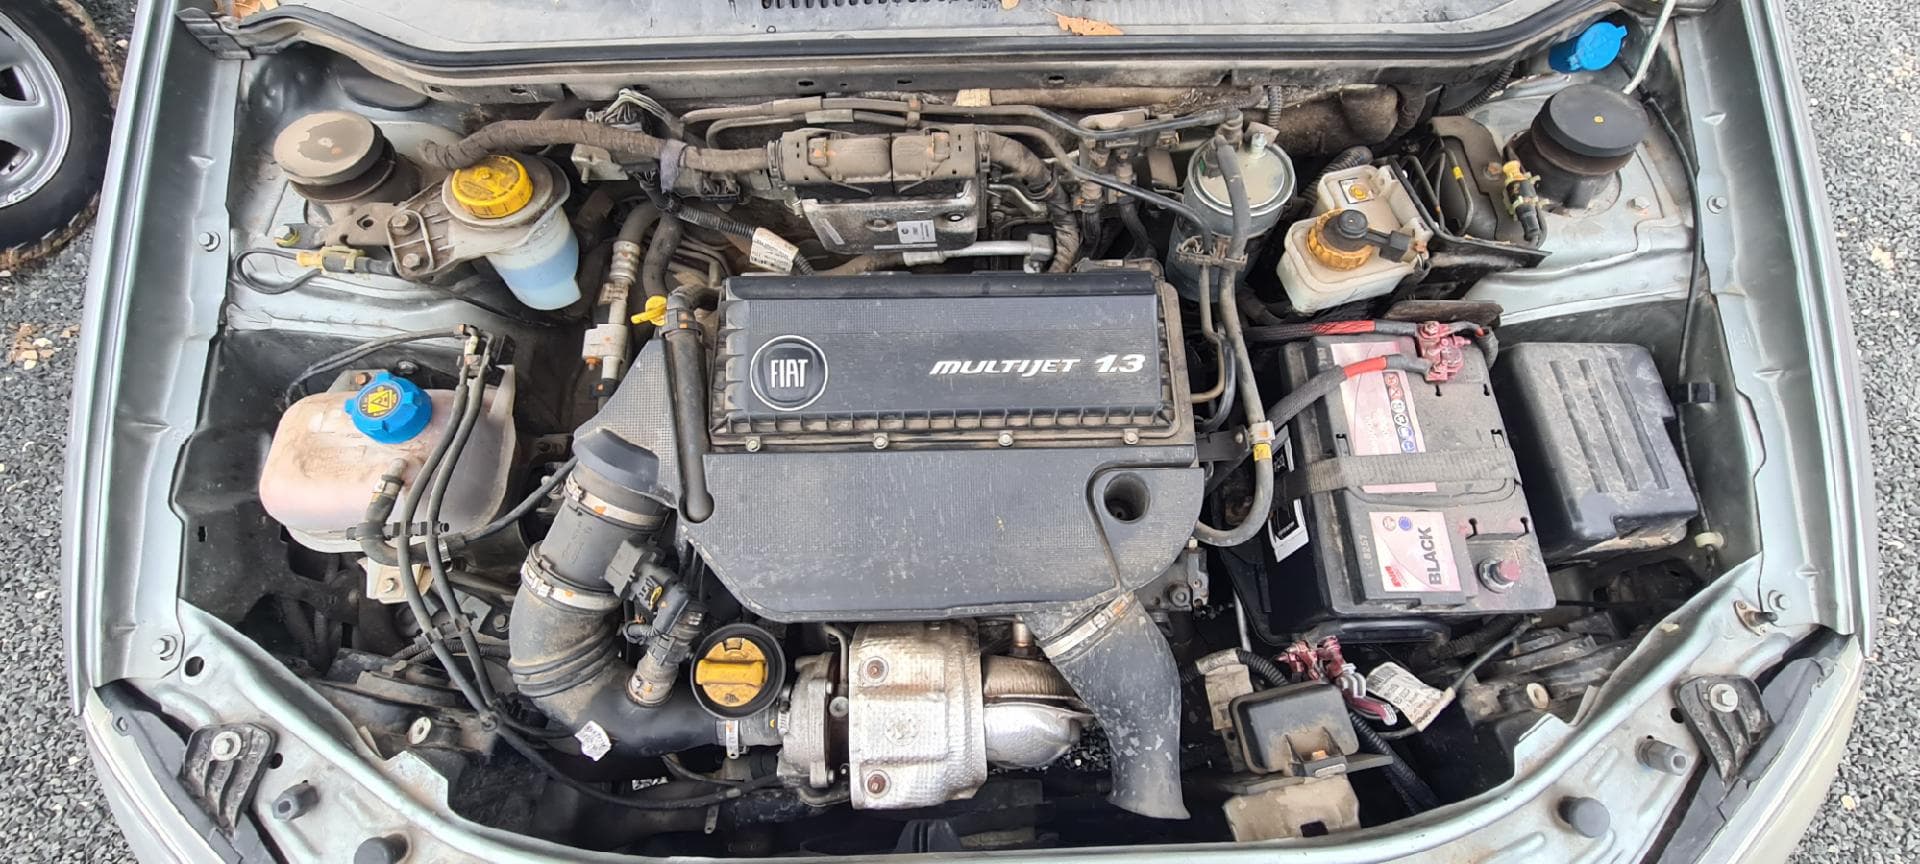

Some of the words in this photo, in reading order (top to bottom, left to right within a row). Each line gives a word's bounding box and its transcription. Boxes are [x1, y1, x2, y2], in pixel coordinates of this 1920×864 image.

[770, 358, 809, 389] FIAT
[929, 358, 1081, 377] MULTIJET
[1095, 353, 1146, 373] 1.3
[1417, 526, 1442, 585] BLACK
